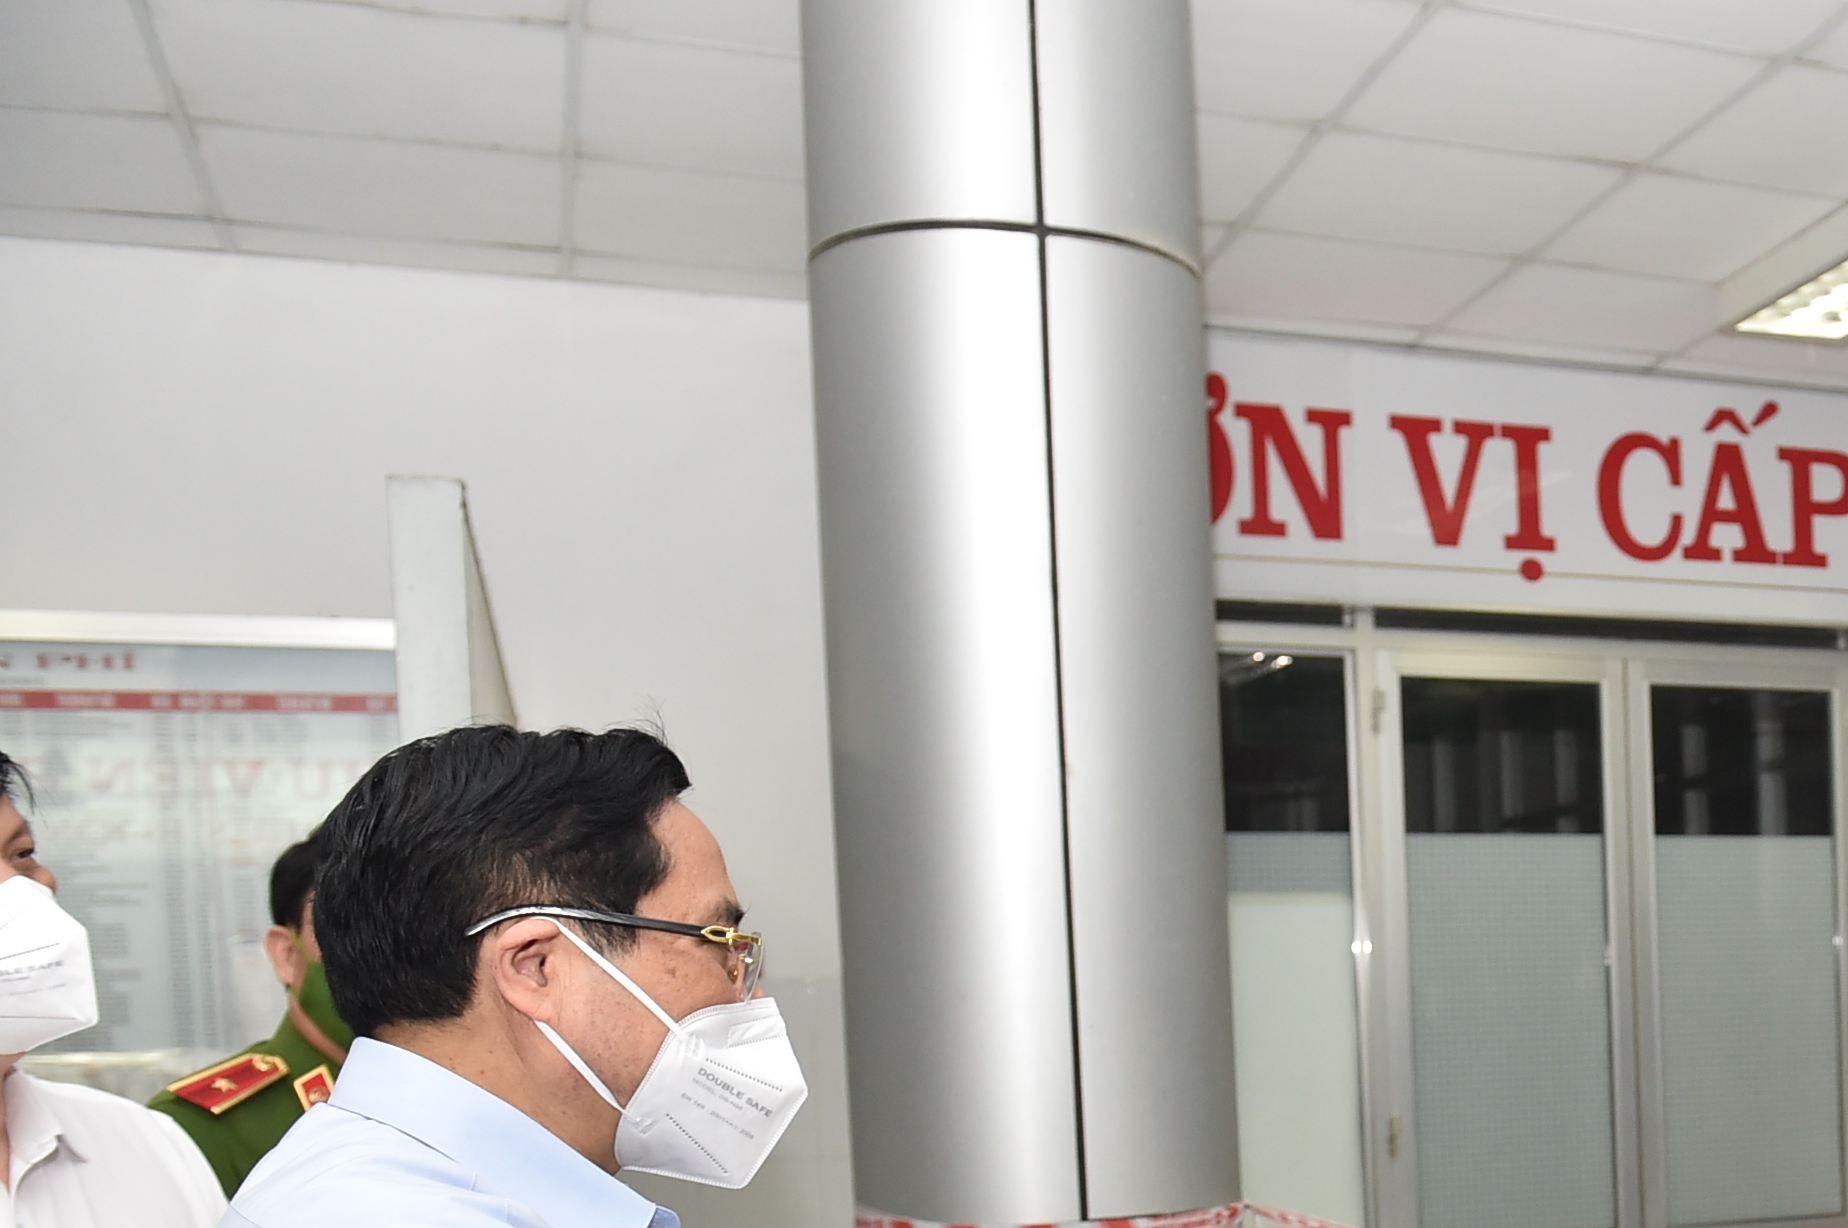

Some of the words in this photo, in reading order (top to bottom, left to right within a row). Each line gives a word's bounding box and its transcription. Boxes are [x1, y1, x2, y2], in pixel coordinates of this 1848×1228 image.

[1390, 415, 1556, 583] VỊ
[697, 1067, 745, 1100] DOUBLE
[745, 1097, 773, 1118] SAFE
